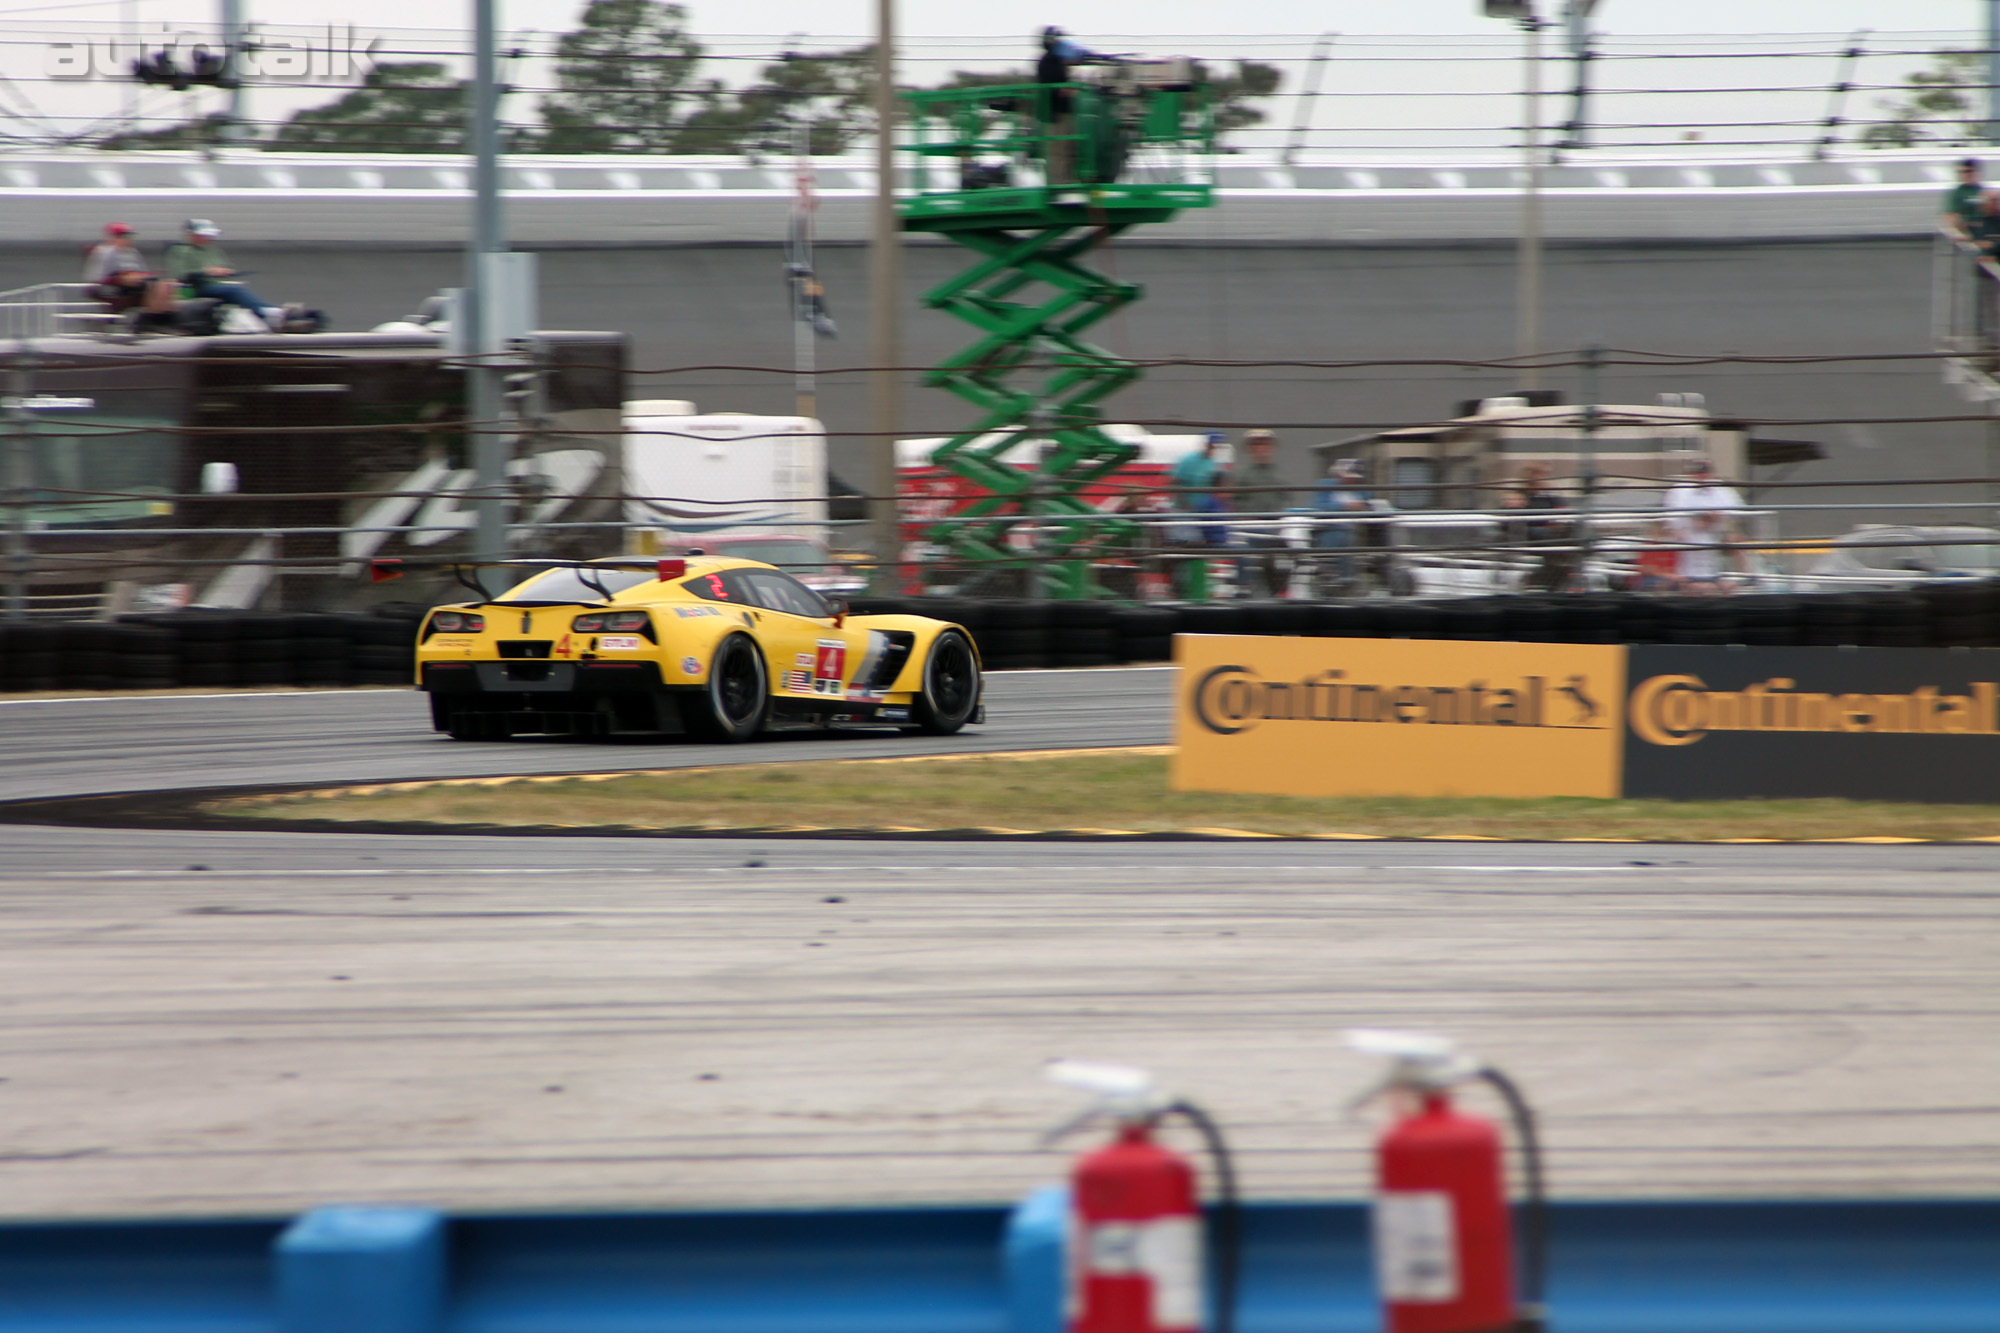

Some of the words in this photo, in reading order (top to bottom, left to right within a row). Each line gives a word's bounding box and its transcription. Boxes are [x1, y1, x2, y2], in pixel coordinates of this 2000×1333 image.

[705, 574, 729, 598] 2
[555, 632, 572, 658] 4
[823, 648, 838, 678] 4
[1193, 664, 1547, 735] Continental
[1629, 674, 2000, 745] Continental
